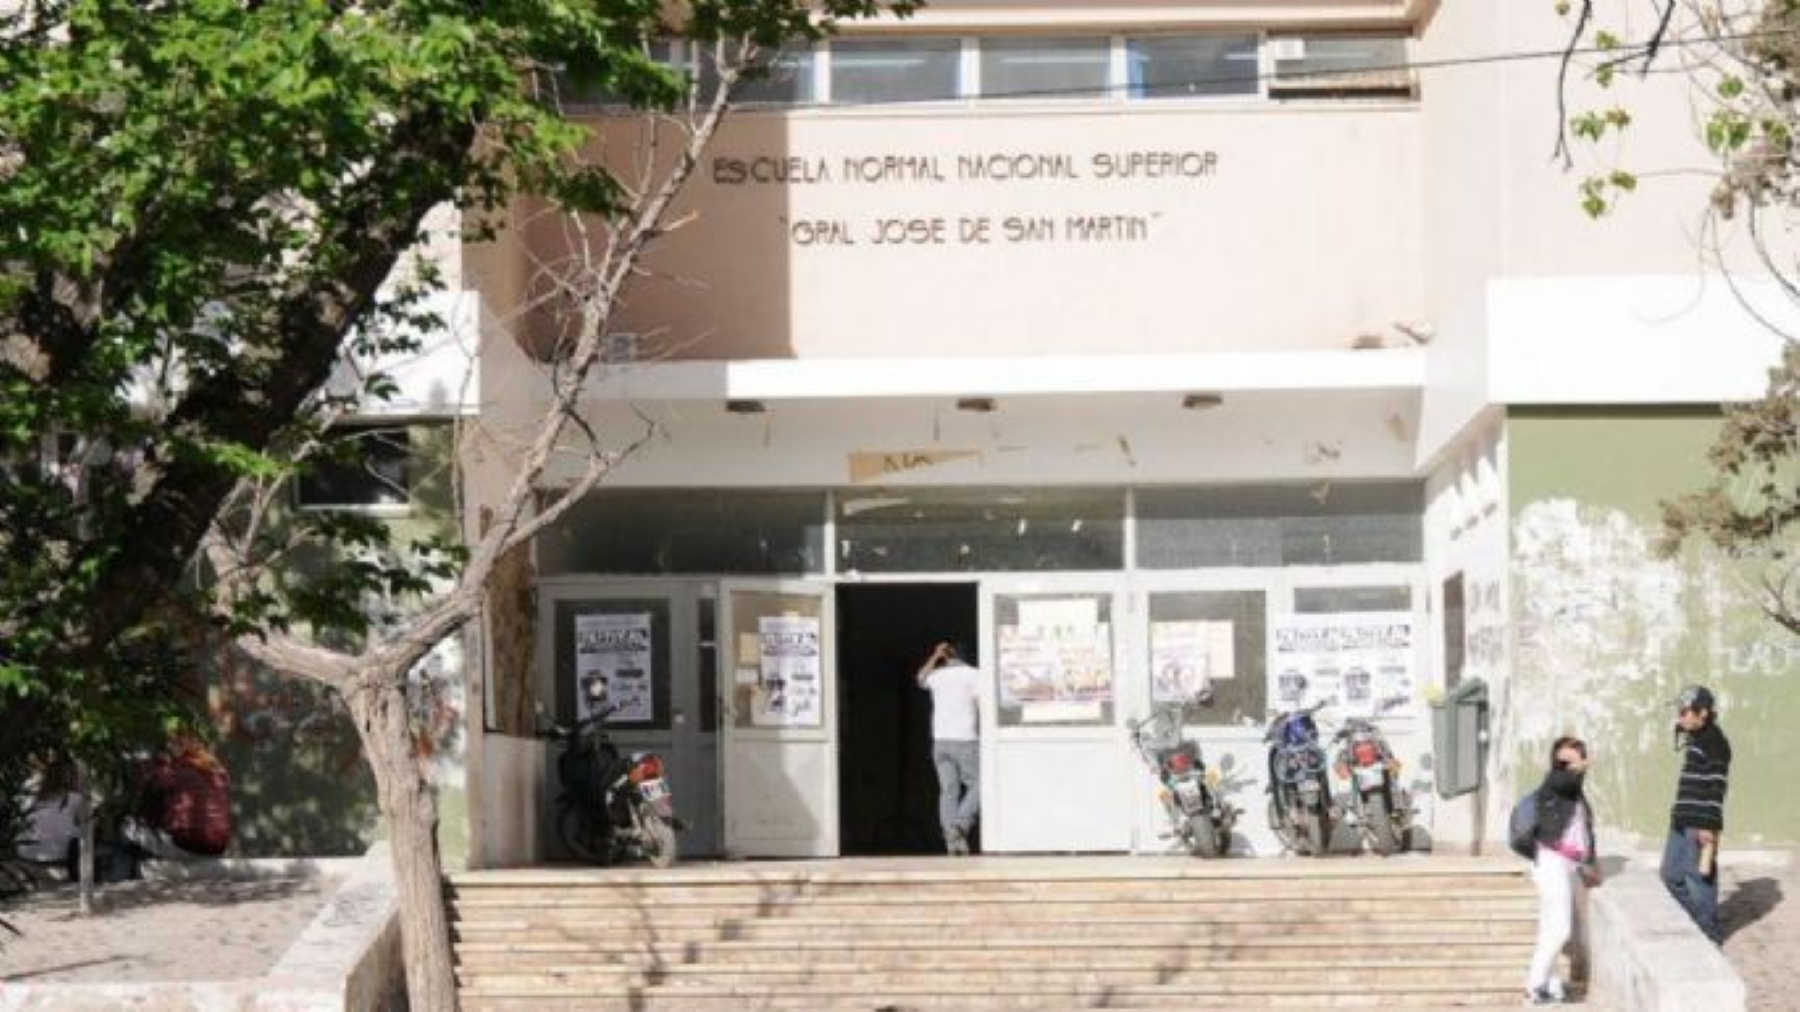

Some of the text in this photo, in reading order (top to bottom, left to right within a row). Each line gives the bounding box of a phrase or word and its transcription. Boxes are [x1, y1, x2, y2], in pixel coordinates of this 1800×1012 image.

[713, 150, 1218, 184] ESCUELA NORMAL NACIONAL SUPERIOR
[872, 218, 946, 244] JOSE
[958, 217, 990, 243] DE
[1003, 216, 1054, 241] SAN
